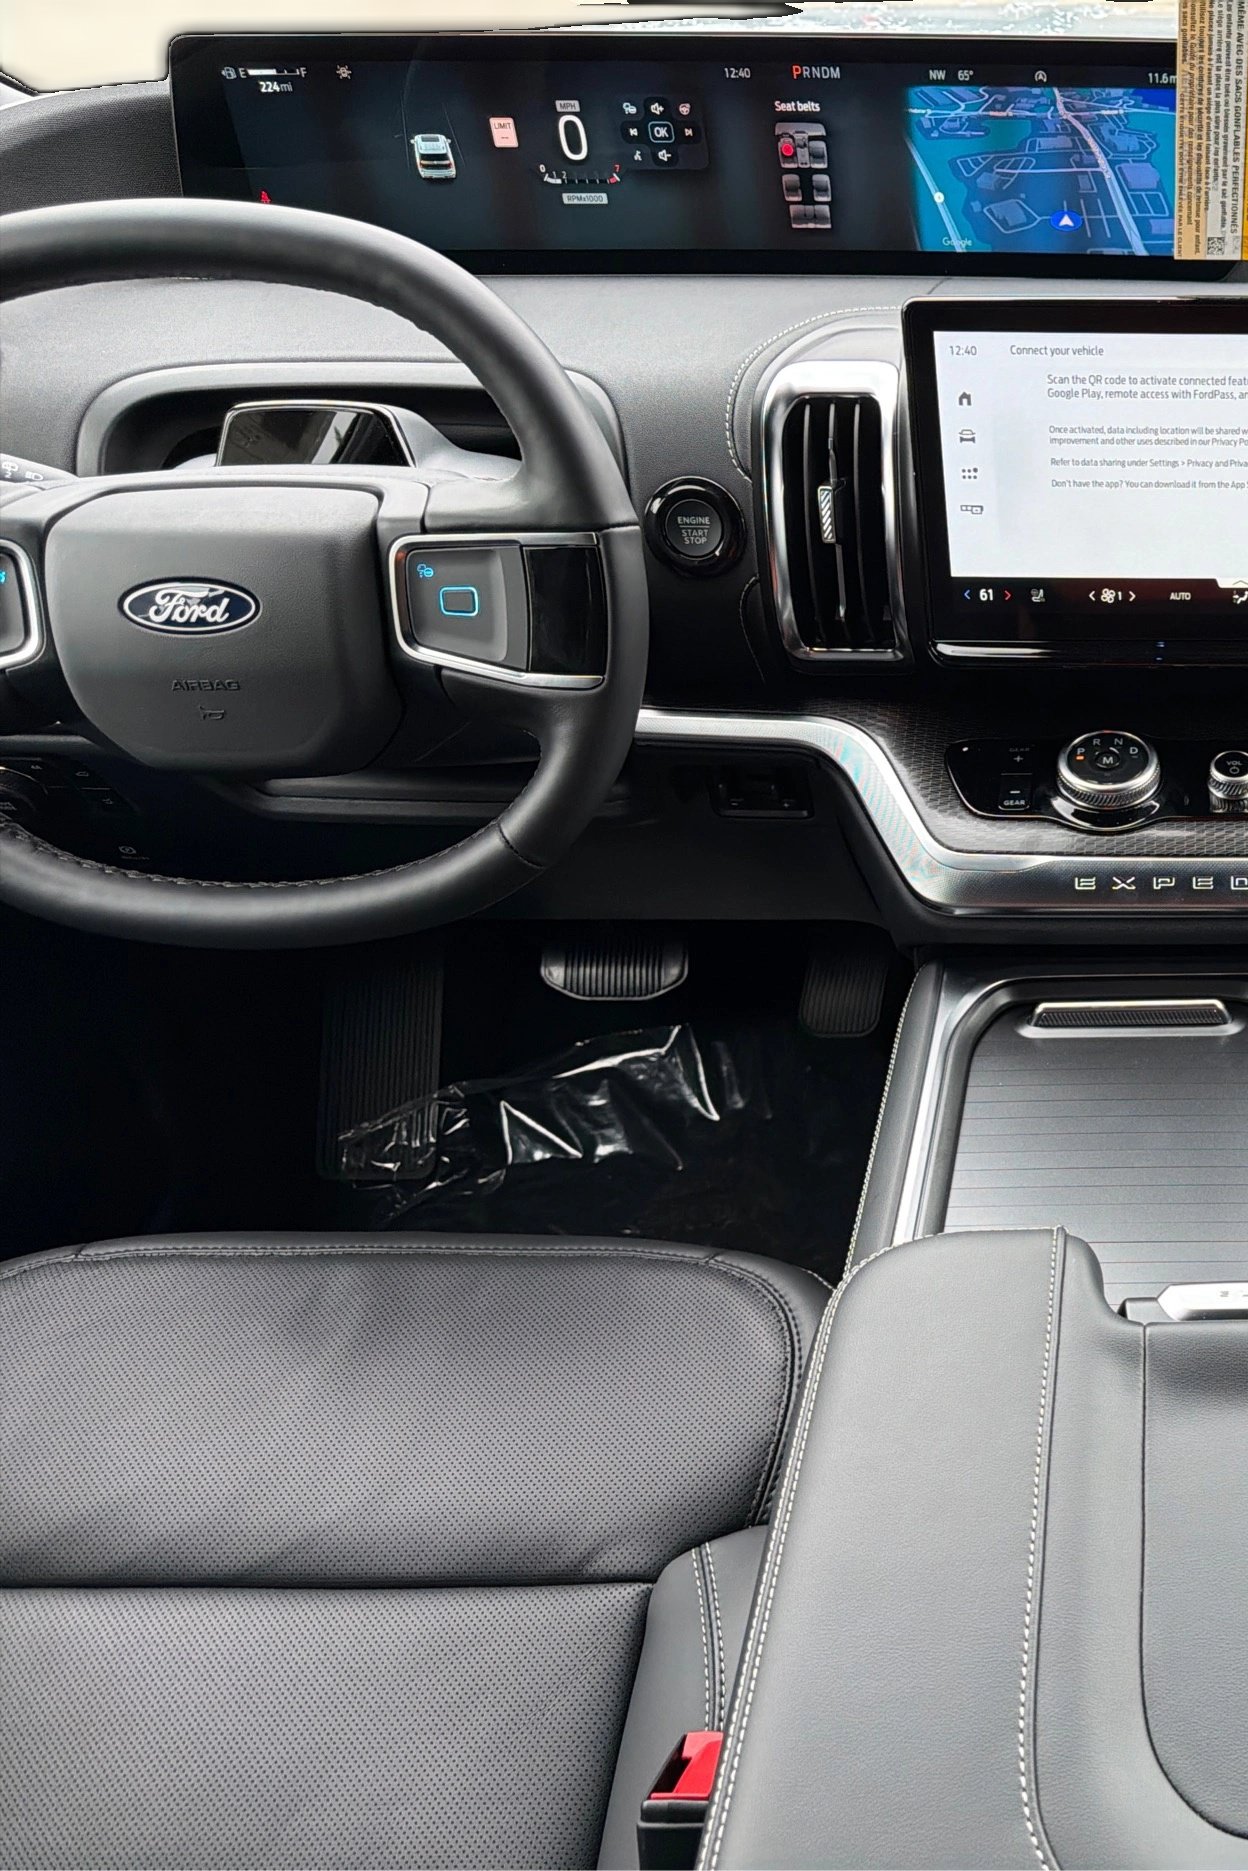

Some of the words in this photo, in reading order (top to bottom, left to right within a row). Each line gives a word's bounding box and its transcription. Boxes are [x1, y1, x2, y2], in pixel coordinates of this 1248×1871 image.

[1237, 0, 1246, 29] MÊME
[1236, 32, 1244, 55] AVEC
[1236, 58, 1244, 75] DES
[724, 67, 751, 79] 12:40
[929, 69, 946, 80] NW
[957, 70, 974, 81] 65°
[1235, 78, 1243, 103] SACS
[774, 101, 796, 112] Seat
[796, 101, 820, 112] belts
[494, 122, 511, 130] LIMIT
[558, 115, 588, 161] 0
[654, 127, 669, 138] OK
[1233, 105, 1242, 162] GONFLABLES
[1231, 165, 1240, 233] PERFECTIONNÉS
[949, 345, 977, 355] 12:40
[1009, 344, 1047, 355] Connect
[1049, 347, 1070, 357] your
[1071, 344, 1104, 356] vehicle
[1047, 374, 1069, 384] Scan
[1071, 374, 1086, 384] the
[1088, 374, 1102, 386] QR
[1104, 374, 1126, 384] code
[1128, 375, 1138, 385] to
[1139, 375, 1176, 385] activate
[1178, 375, 1226, 386] connected
[1047, 387, 1079, 399] Google
[1081, 388, 1103, 400] Play,
[1105, 389, 1138, 398] remote
[1140, 390, 1169, 399] access
[1170, 389, 1191, 399] with
[1193, 389, 1236, 400] FordPass,
[1048, 425, 1068, 433] Once
[1068, 425, 1106, 435] activated,
[1106, 425, 1124, 434] data
[1125, 426, 1158, 436] including
[1159, 426, 1189, 434] location
[1190, 426, 1203, 435] will
[1204, 426, 1214, 435] be
[1215, 426, 1240, 435] shared
[1049, 436, 1099, 446] improvement
[1100, 436, 1114, 445] and
[1115, 436, 1135, 445] other
[1154, 437, 1189, 445] described
[1211, 437, 1238, 447] Privacy
[1050, 457, 1070, 466] Refer
[1071, 458, 1080, 466] to
[1080, 458, 1098, 466] data
[1099, 458, 1126, 468] sharing
[1126, 458, 1148, 466] under
[1149, 458, 1179, 468] Settings
[1186, 458, 1213, 468] Privacy
[1214, 459, 1228, 467] and
[1051, 479, 1071, 487] Don't
[1072, 479, 1090, 487] have
[1091, 479, 1104, 487] the
[1105, 479, 1123, 489] app?
[1124, 480, 1139, 488] You
[1154, 479, 1190, 488] download
[1191, 480, 1196, 488] it
[1198, 480, 1216, 488] from
[1217, 480, 1229, 488] the
[1230, 480, 1245, 490] App
[677, 516, 711, 525] ENGINE
[681, 529, 709, 537] START
[684, 536, 708, 545] STOP
[979, 589, 994, 601] 61
[1117, 591, 1122, 601] 1
[1169, 591, 1191, 601] AUTO
[148, 588, 230, 623] Ford
[171, 679, 242, 692] AIRBAG
[1092, 738, 1101, 746] R
[1114, 738, 1123, 746] N
[1076, 747, 1086, 756] P
[1129, 746, 1139, 755] D
[1102, 756, 1114, 765] M
